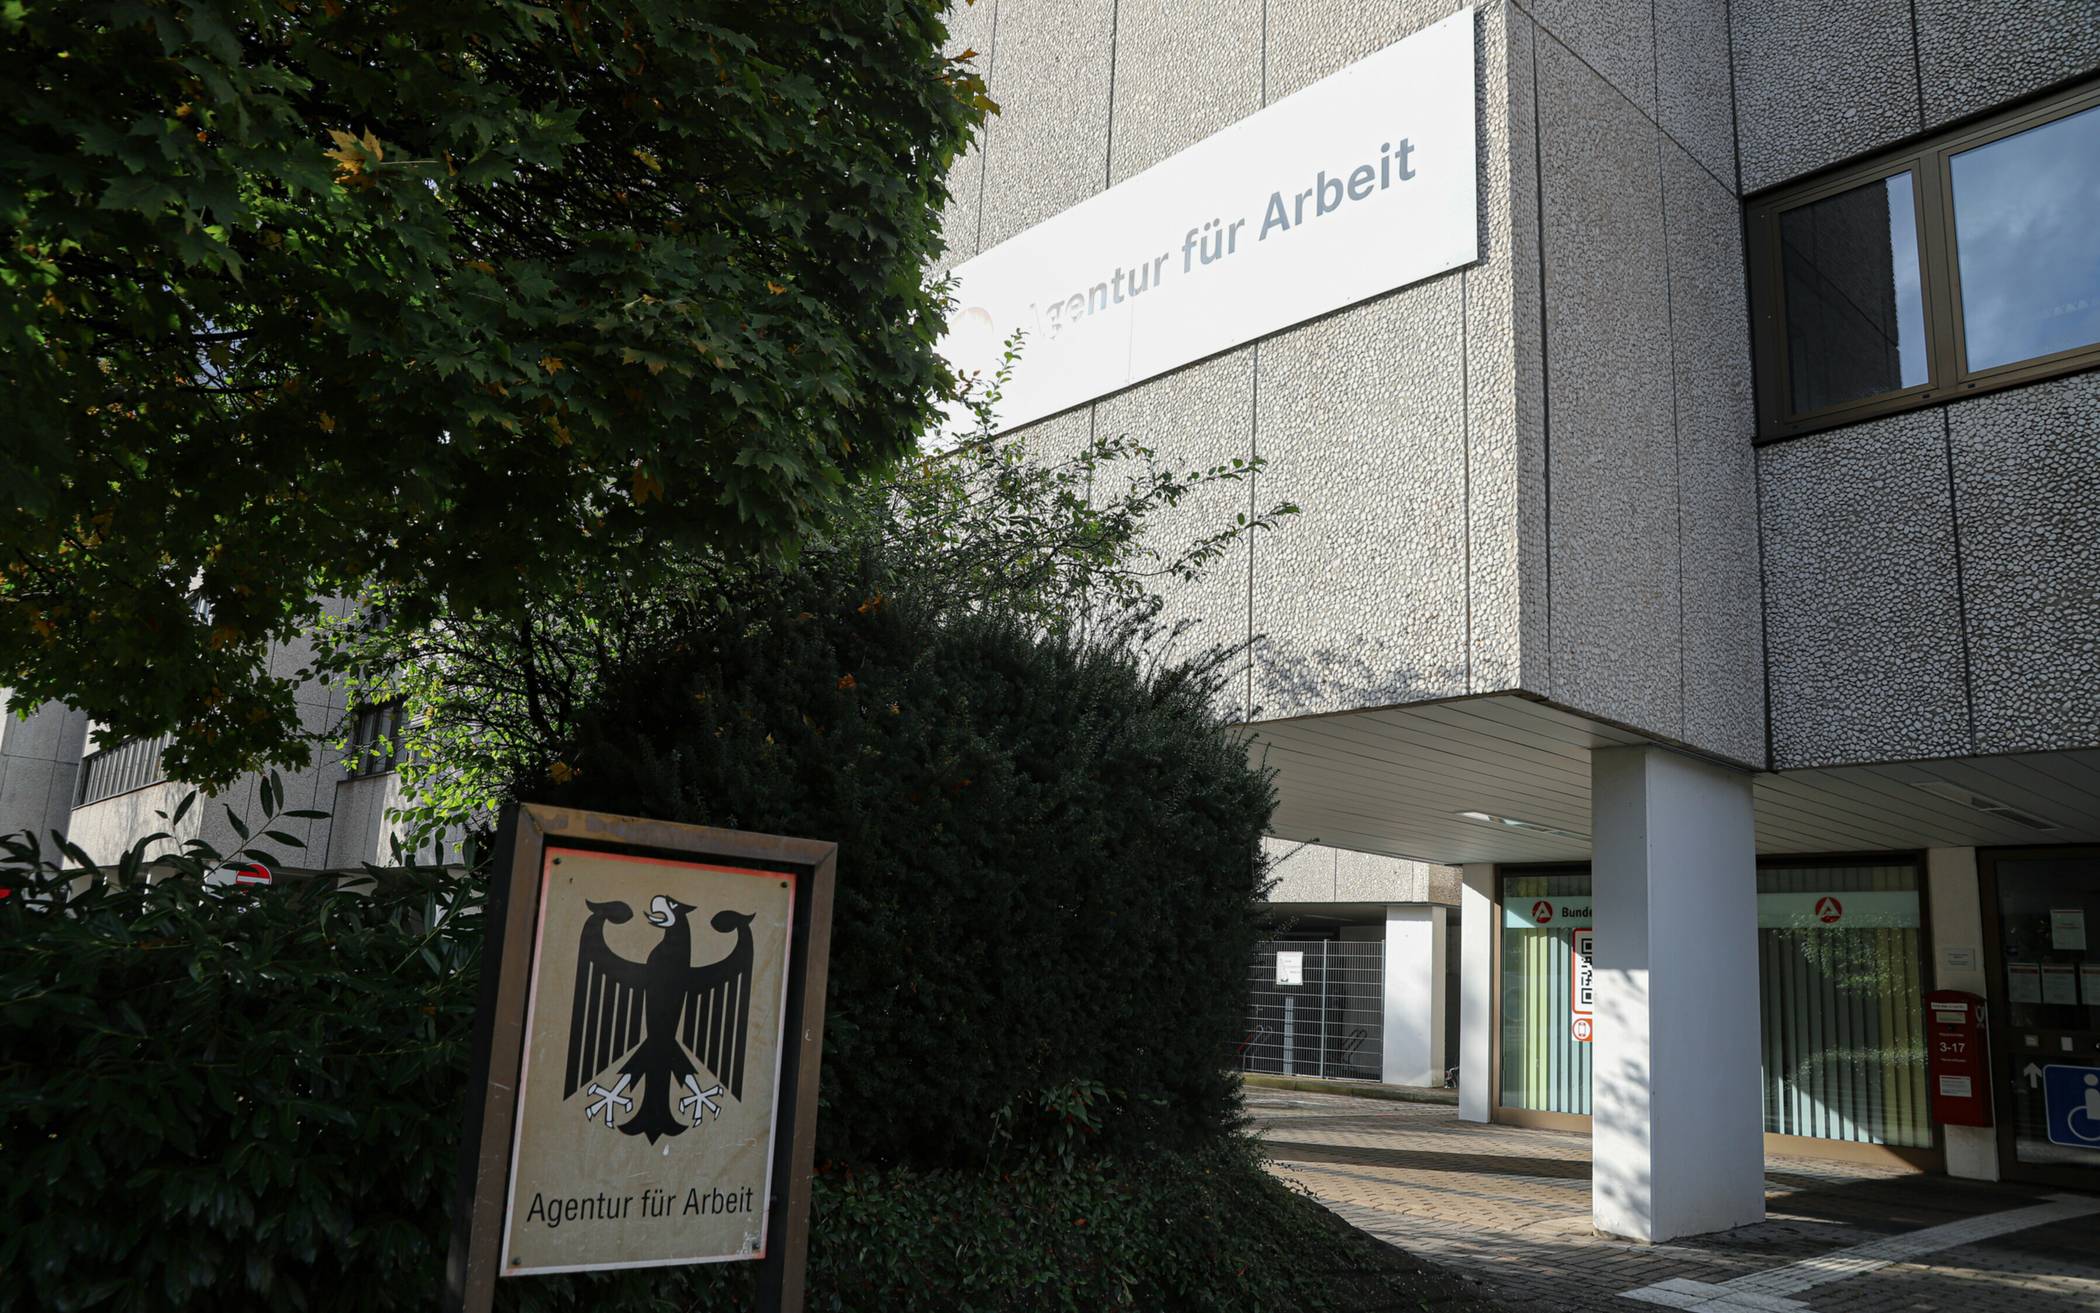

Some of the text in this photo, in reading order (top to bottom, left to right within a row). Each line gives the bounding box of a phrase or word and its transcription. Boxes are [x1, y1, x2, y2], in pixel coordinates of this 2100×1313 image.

[1029, 137, 1417, 341] gentur für Arbeit
[1940, 1041, 1966, 1053] 3-17
[526, 1186, 754, 1229] Agentur für Arbeit
